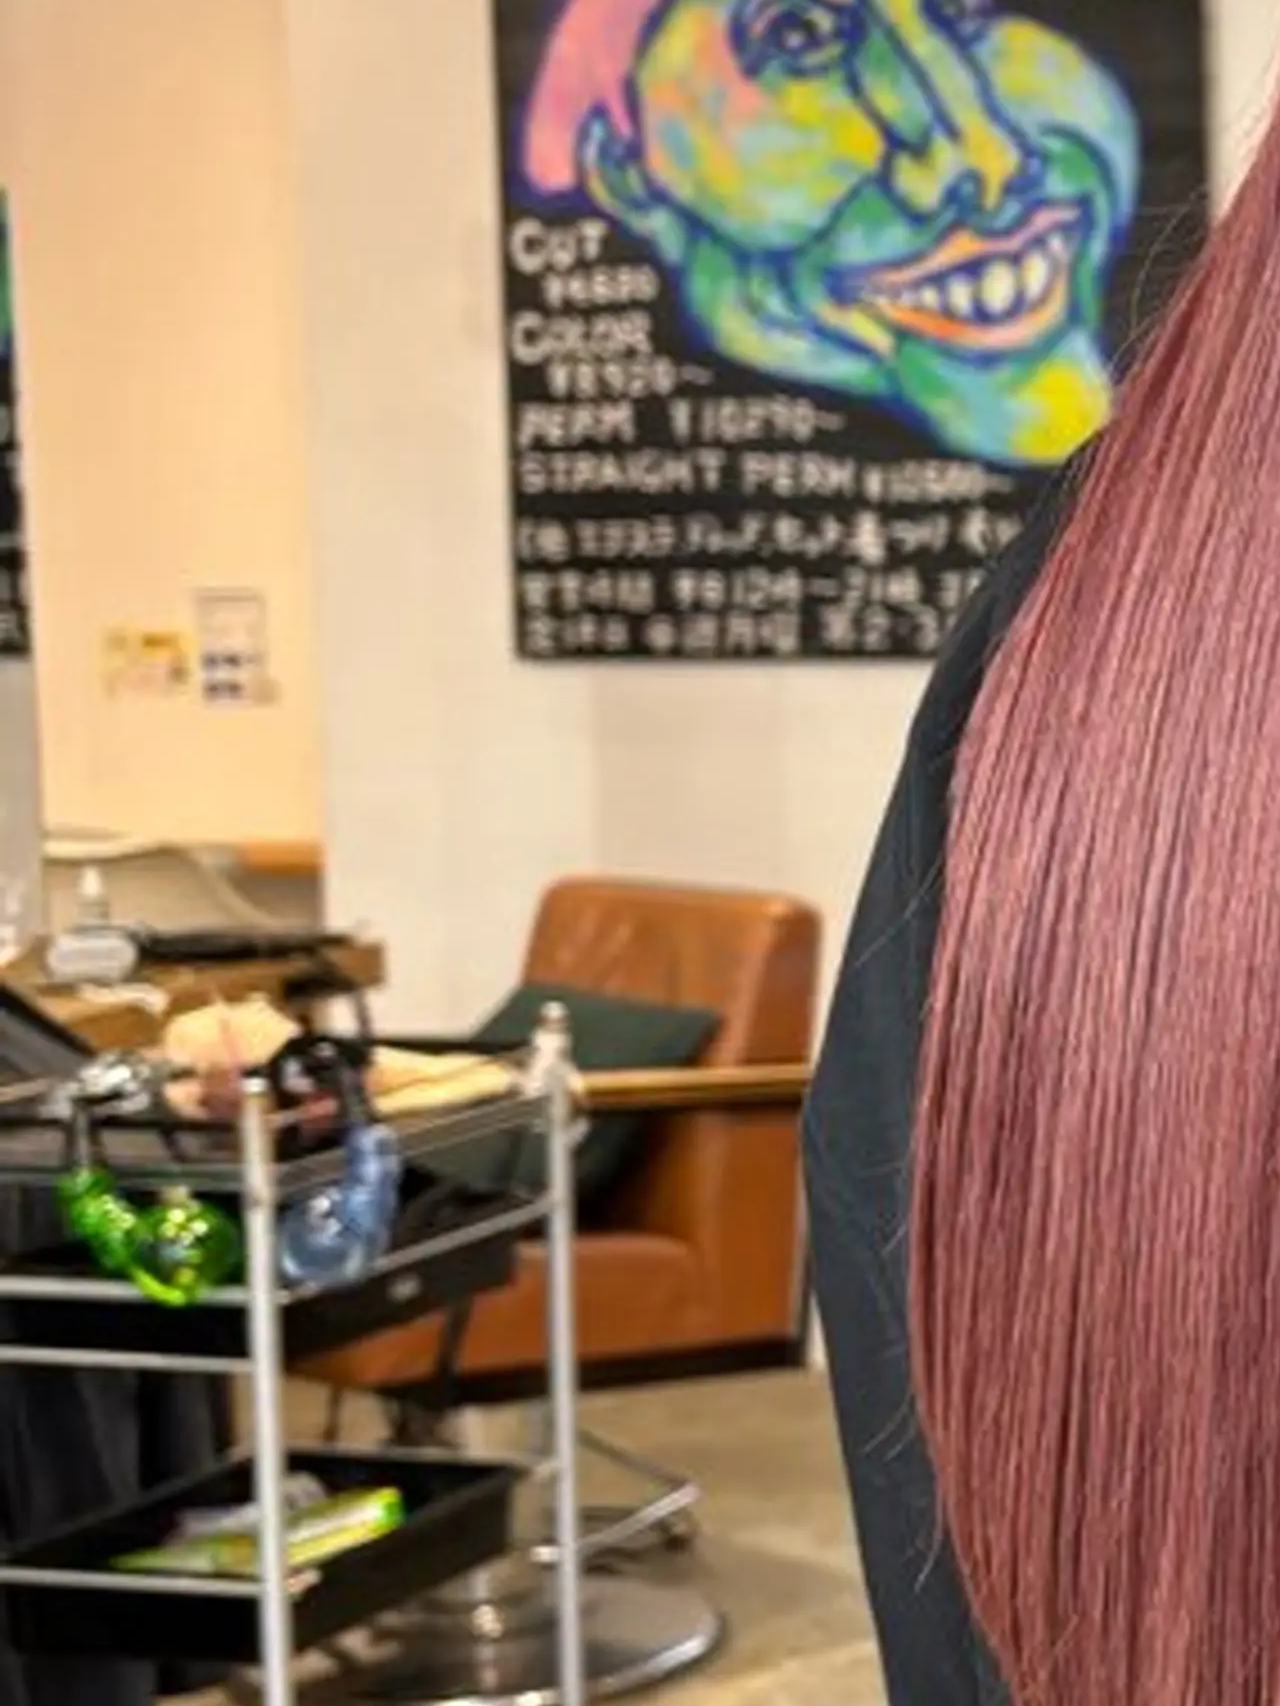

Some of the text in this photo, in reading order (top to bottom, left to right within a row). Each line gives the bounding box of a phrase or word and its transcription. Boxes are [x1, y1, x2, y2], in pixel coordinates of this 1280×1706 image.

[518, 399, 637, 450] PERM
[518, 447, 727, 496] STRAIGHT
[739, 450, 856, 500] PERM
